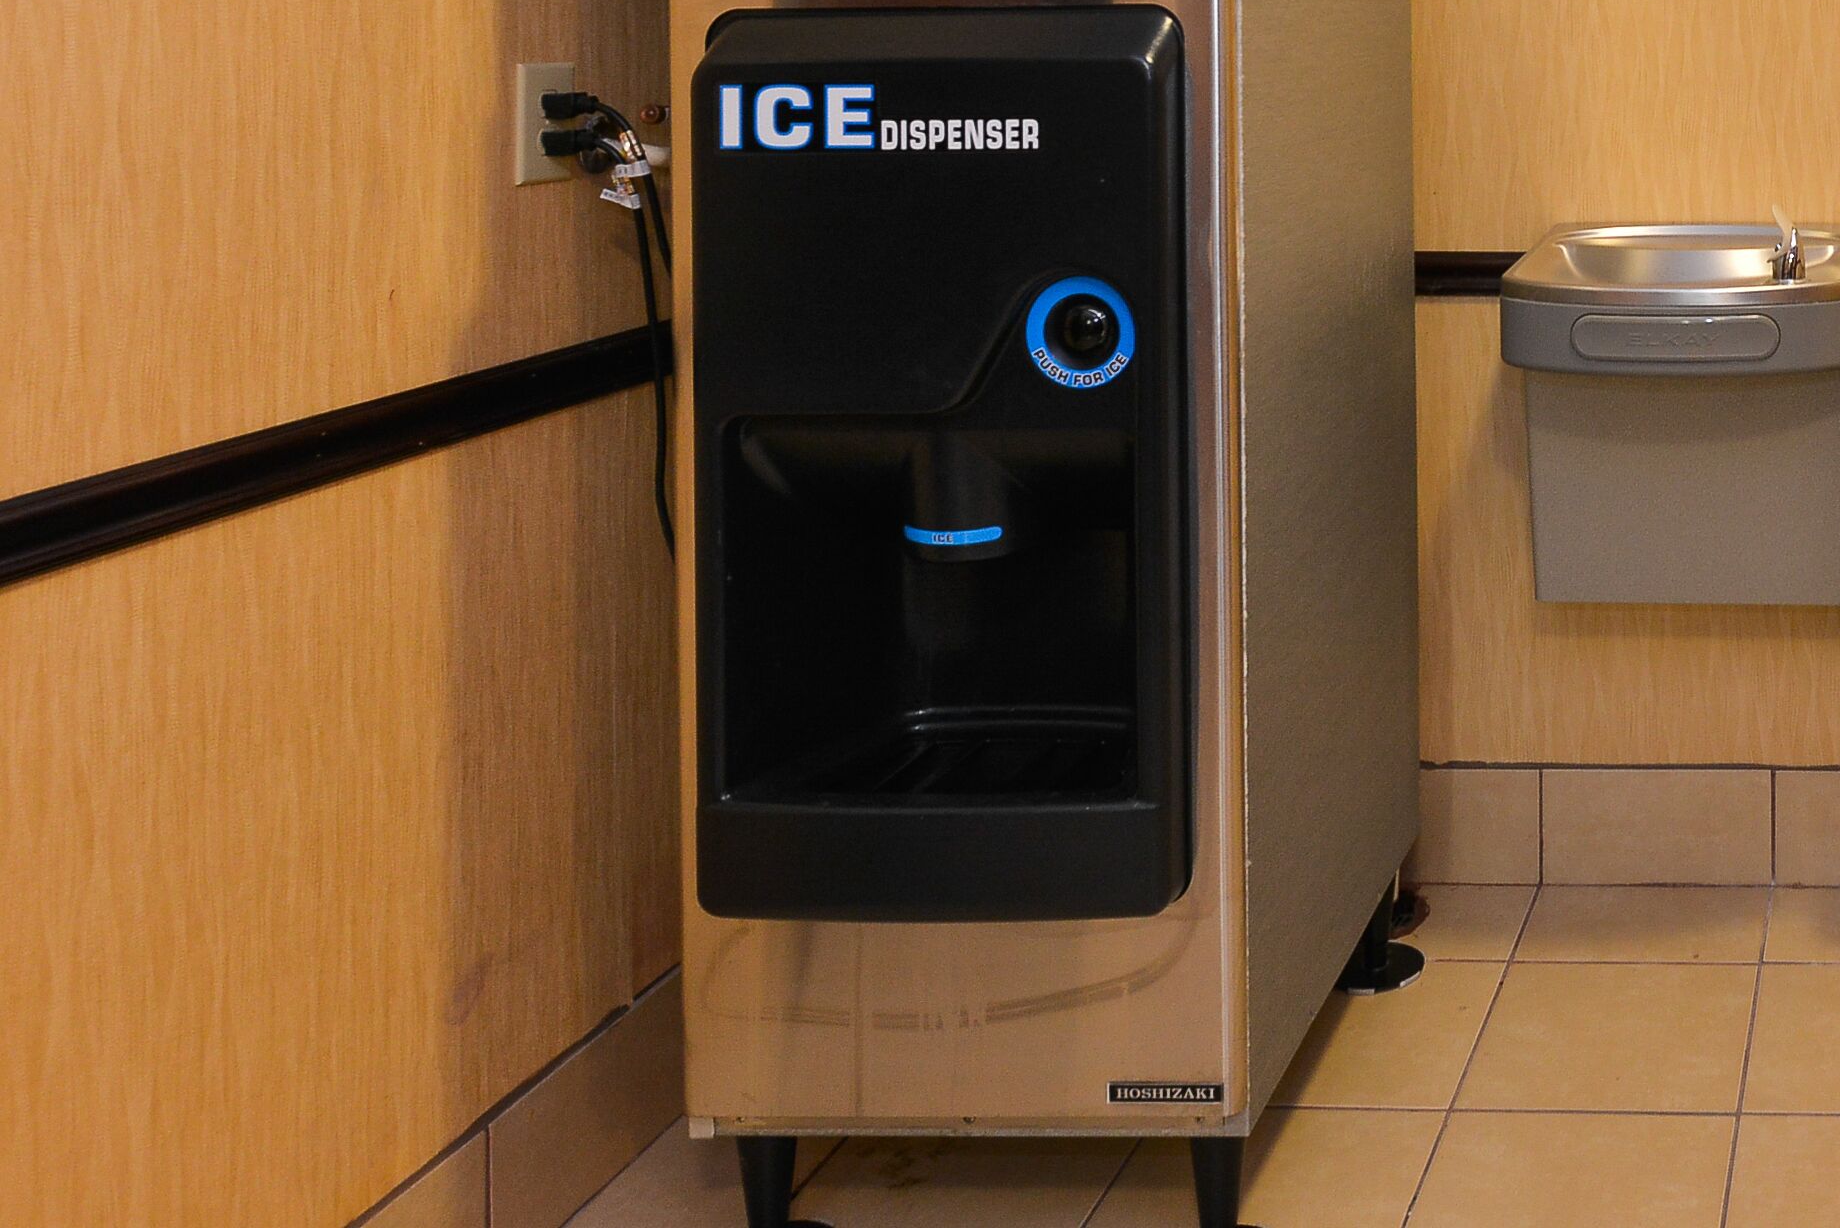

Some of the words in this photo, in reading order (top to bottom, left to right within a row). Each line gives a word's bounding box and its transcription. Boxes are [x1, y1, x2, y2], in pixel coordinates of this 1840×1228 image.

[719, 83, 876, 151] ICE
[880, 118, 1040, 151] DISPENSER
[1031, 346, 1071, 385] PUSH
[1072, 369, 1105, 388] FOR
[1104, 351, 1130, 378] ICE
[931, 532, 954, 545] ICE
[1116, 1087, 1216, 1100] HOSHIZAKI
